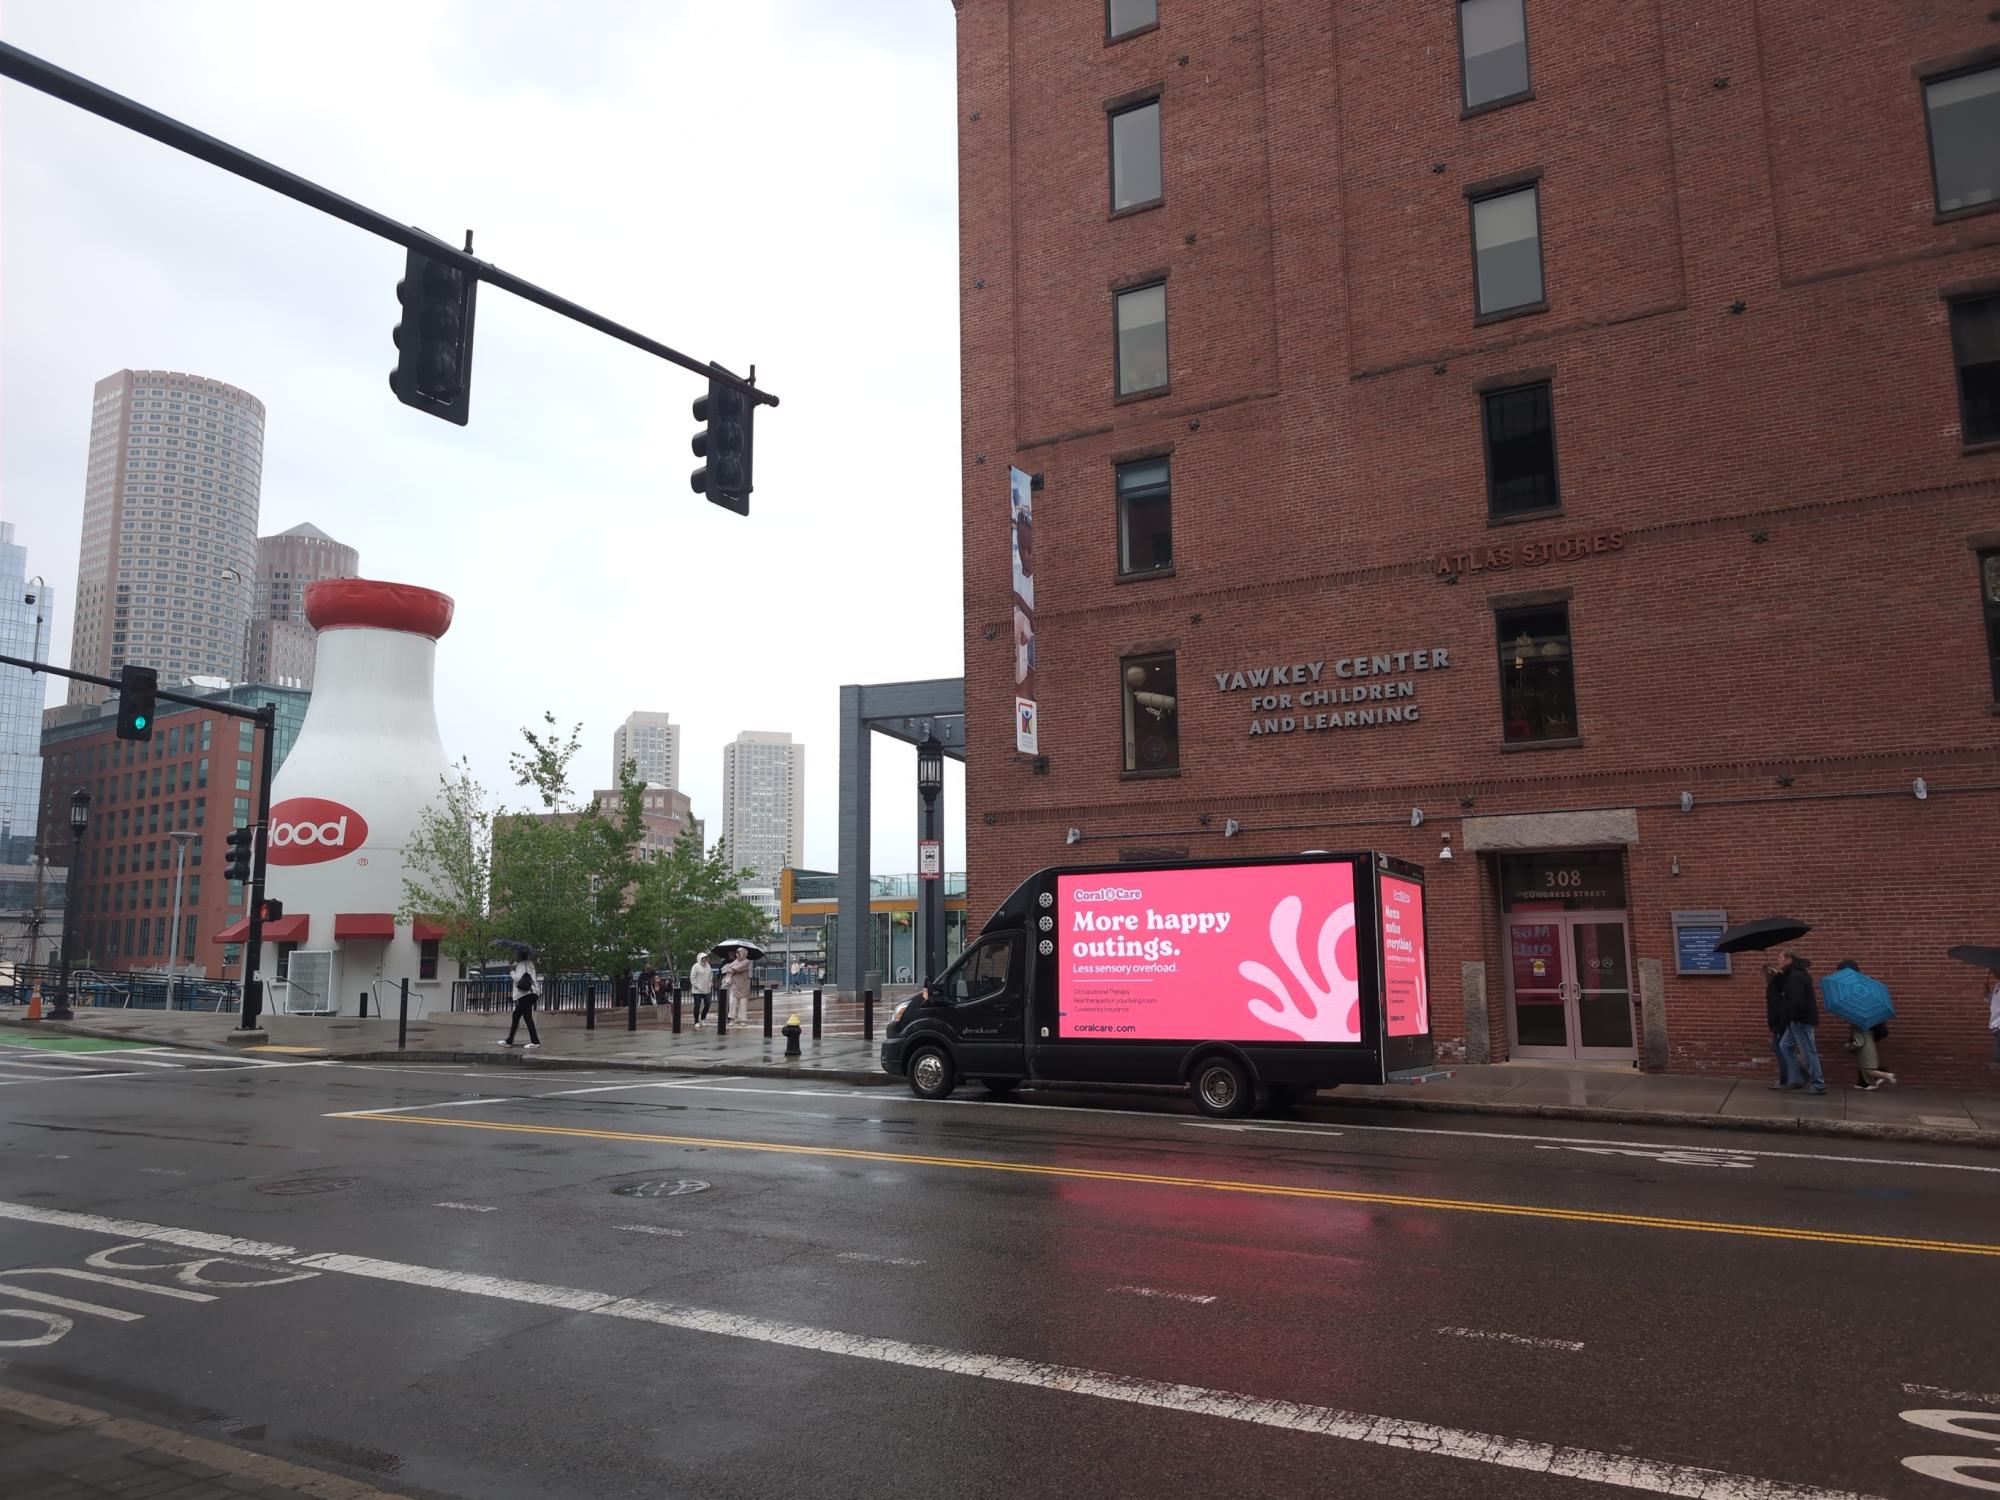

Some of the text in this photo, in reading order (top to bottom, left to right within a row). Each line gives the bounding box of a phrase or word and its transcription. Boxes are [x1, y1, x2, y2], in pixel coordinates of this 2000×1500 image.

[1436, 533, 1624, 576] ATLAS STORES
[1215, 648, 1450, 692] YAWKEY CENTER
[1251, 681, 1414, 712] FOR CHILDREN
[1249, 705, 1420, 735] AND LEARNING
[1545, 870, 1582, 887] 308
[1074, 888, 1142, 900] Coral Care
[1573, 889, 1606, 897] STREET
[1073, 909, 1231, 934] More happy
[1073, 935, 1181, 961] outings.
[1073, 963, 1093, 973] Less
[1094, 964, 1131, 975] sensory
[1074, 1024, 1136, 1032] coralcare.com
